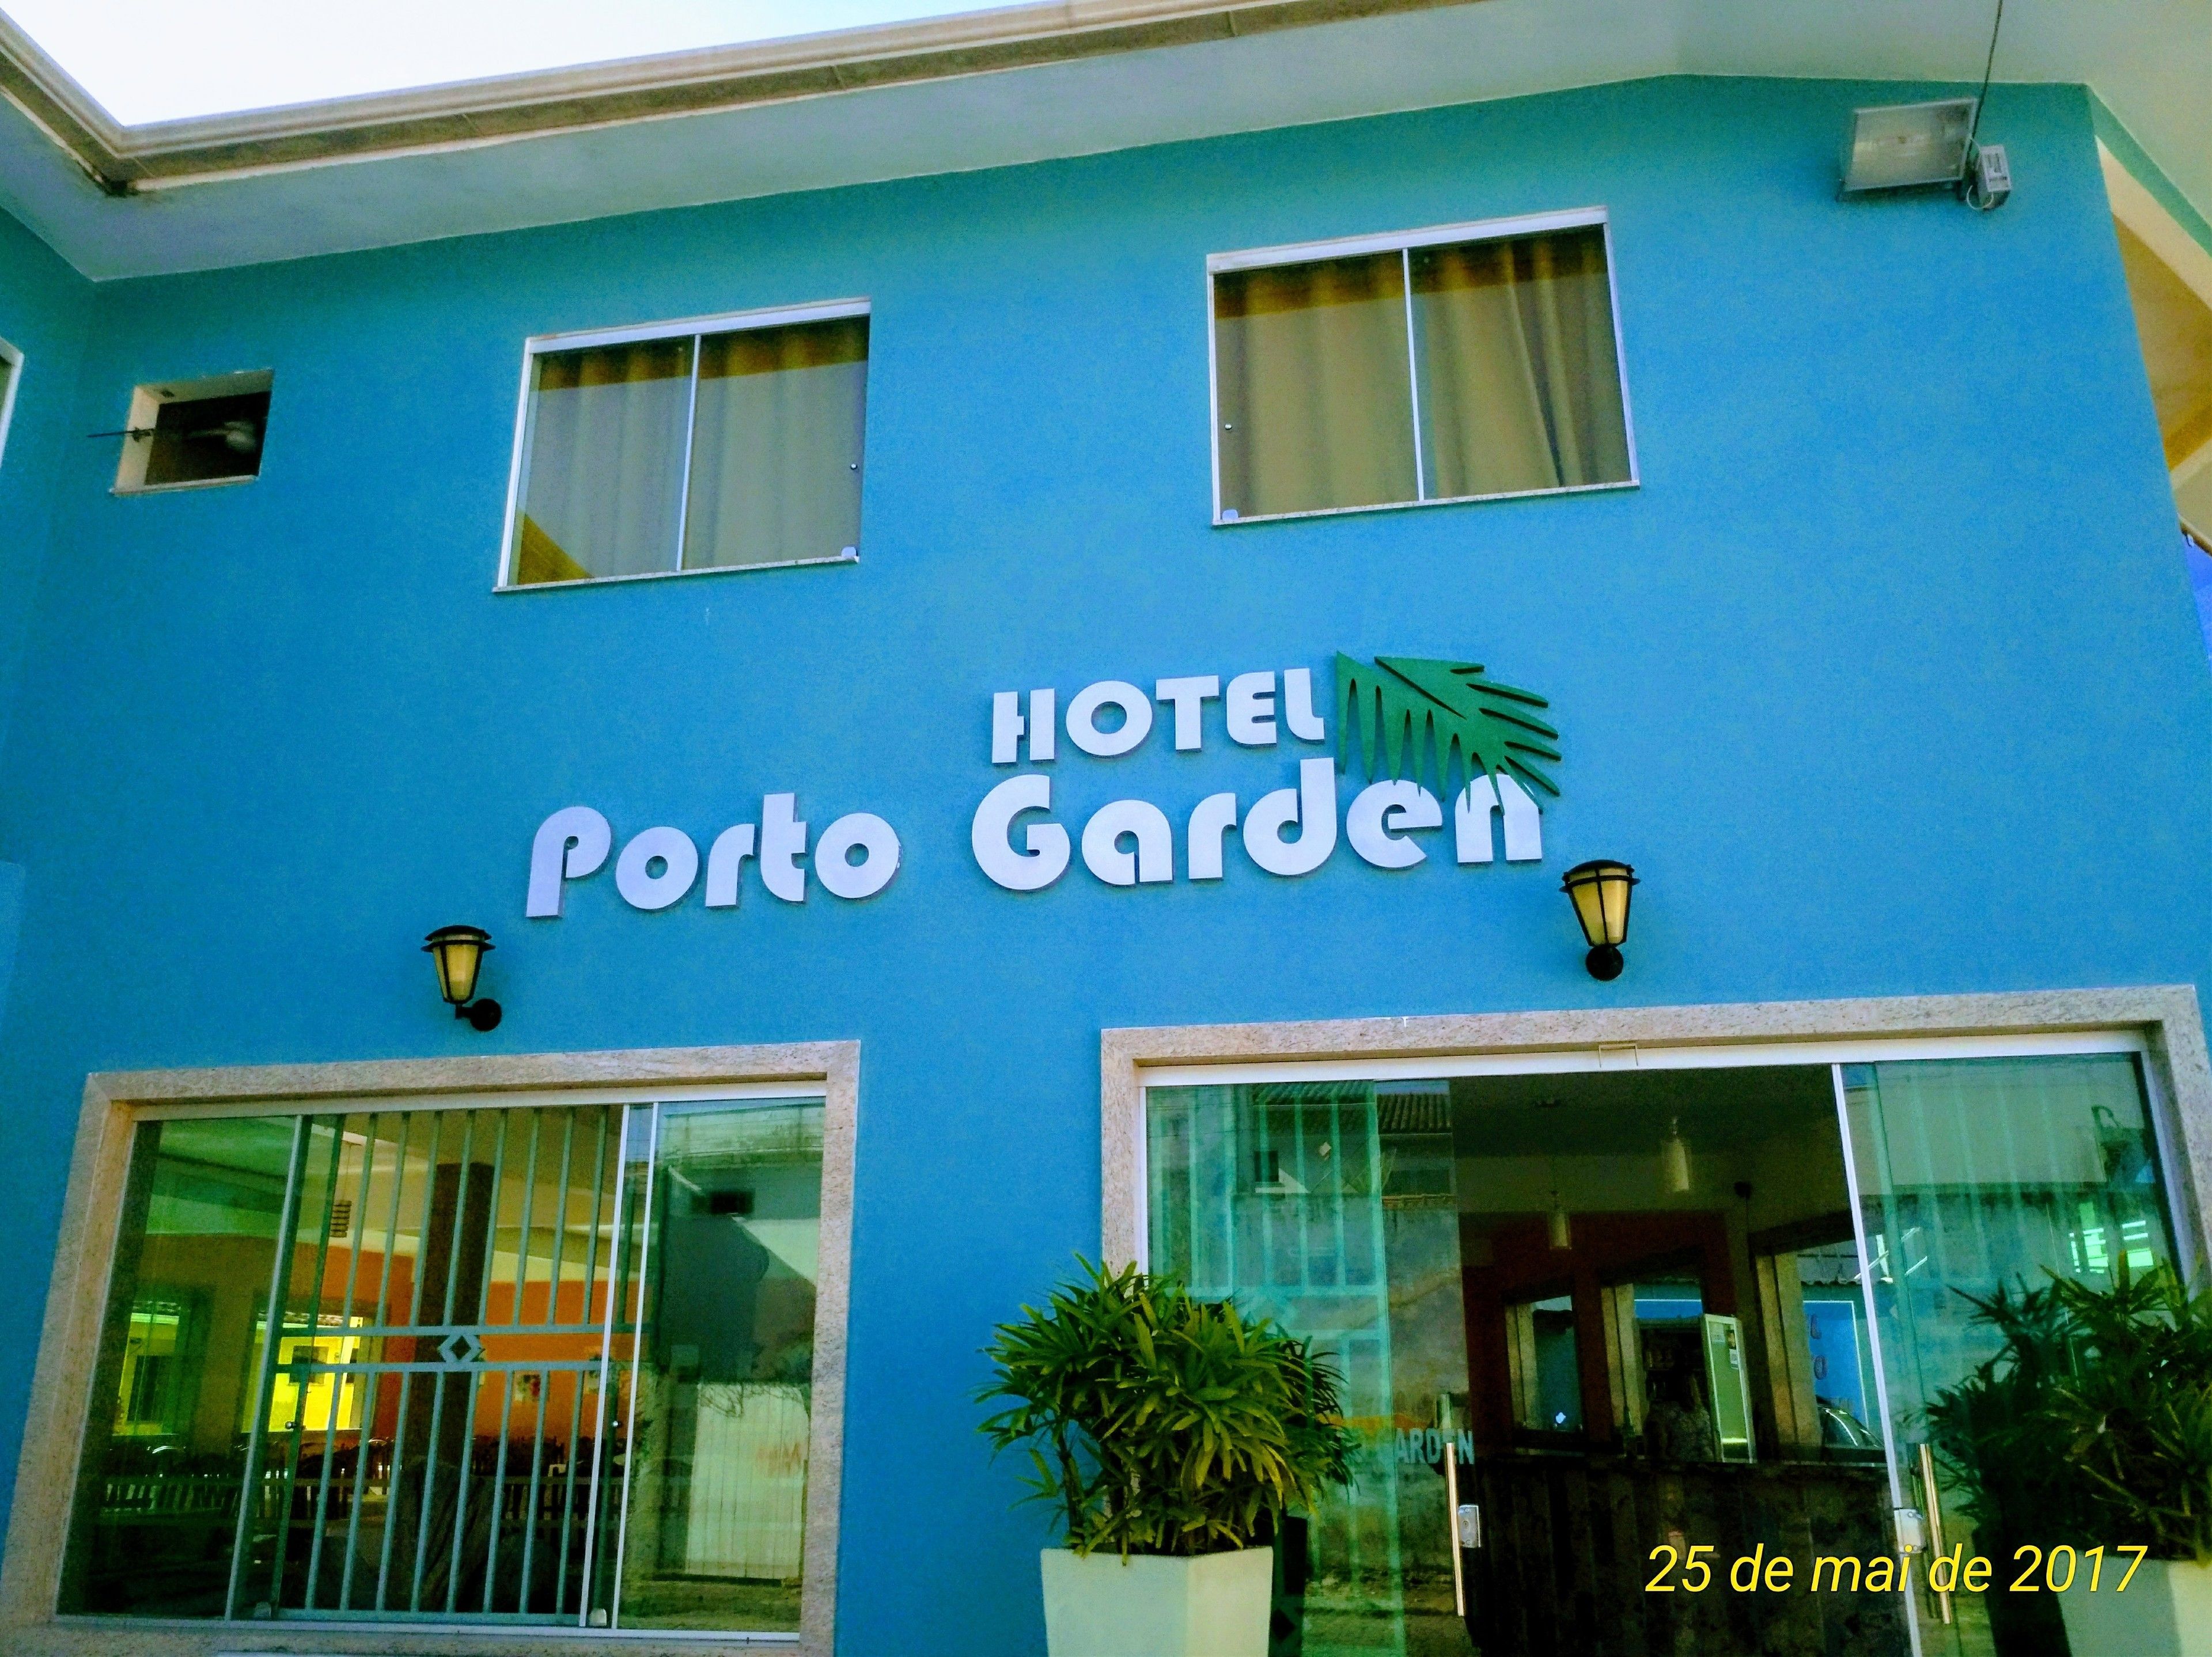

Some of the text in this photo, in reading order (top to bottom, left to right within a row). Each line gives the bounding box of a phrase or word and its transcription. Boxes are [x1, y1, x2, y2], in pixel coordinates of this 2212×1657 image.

[991, 668, 1325, 764] HOTEL
[525, 757, 1543, 917] Porto Garden
